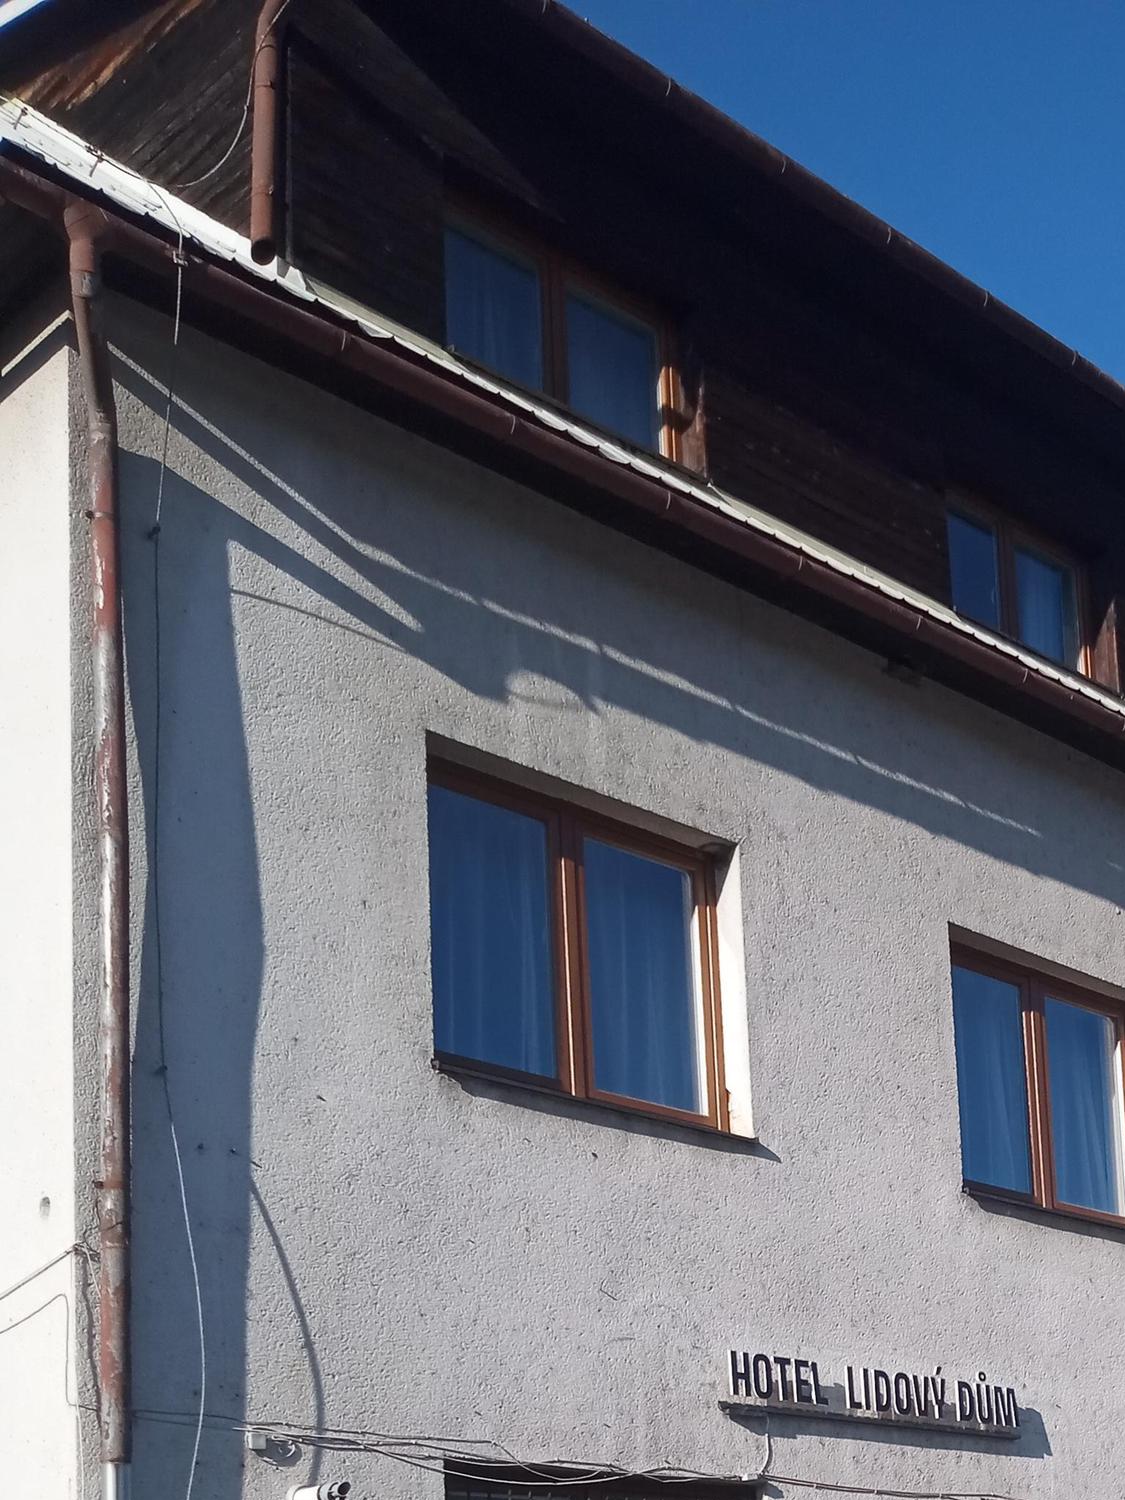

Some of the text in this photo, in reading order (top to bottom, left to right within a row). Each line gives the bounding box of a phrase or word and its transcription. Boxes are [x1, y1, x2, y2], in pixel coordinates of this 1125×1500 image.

[729, 1350, 1020, 1427] HOTEL LIDOVÝ DŮM
